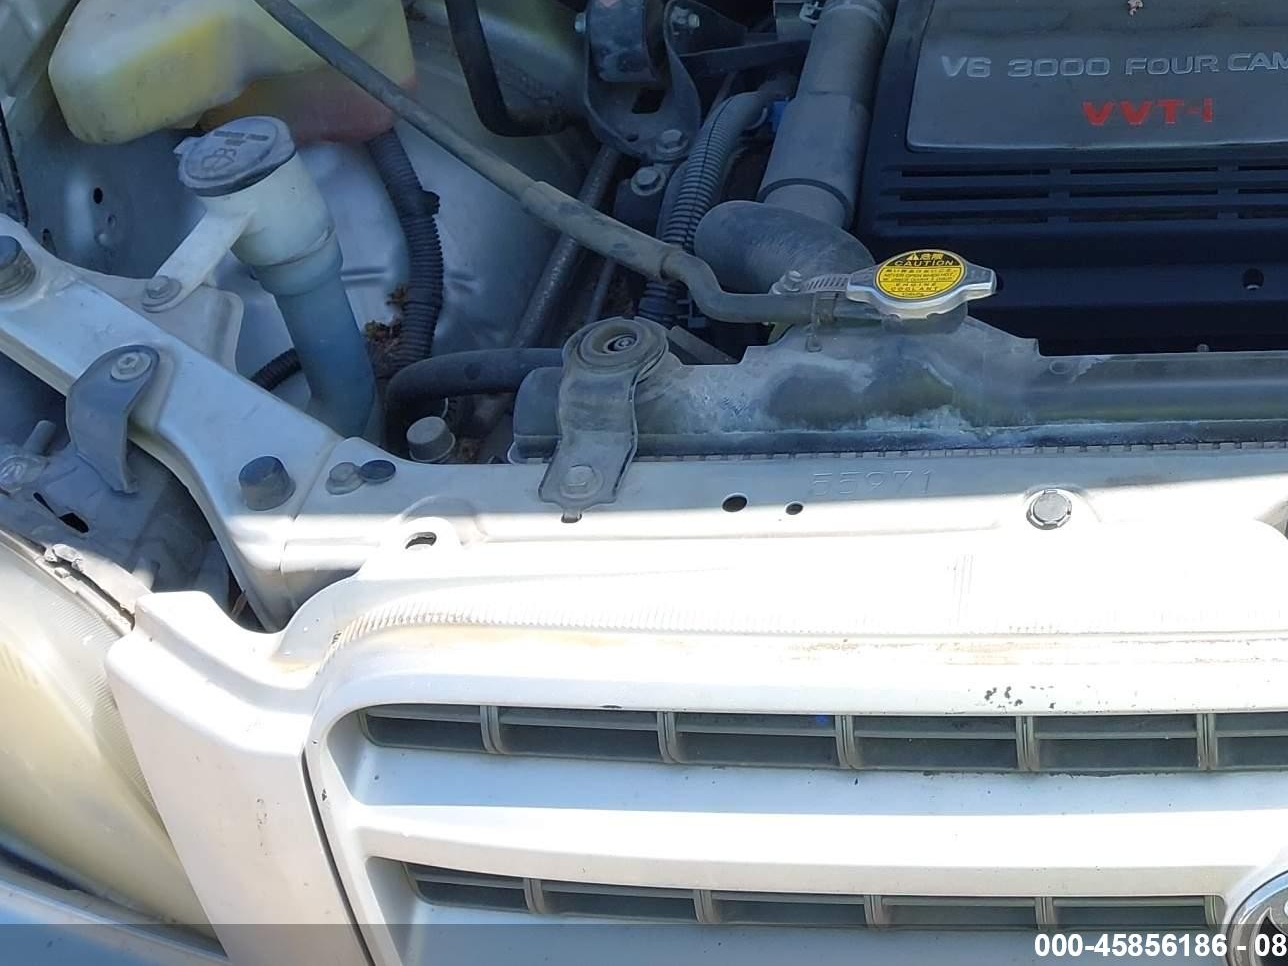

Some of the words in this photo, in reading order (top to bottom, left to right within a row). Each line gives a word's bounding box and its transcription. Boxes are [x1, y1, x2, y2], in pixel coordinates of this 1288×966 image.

[941, 55, 993, 79] V6
[1007, 55, 1111, 77] 3000
[1125, 53, 1220, 75] FOUR
[894, 259, 954, 267] CAUTION
